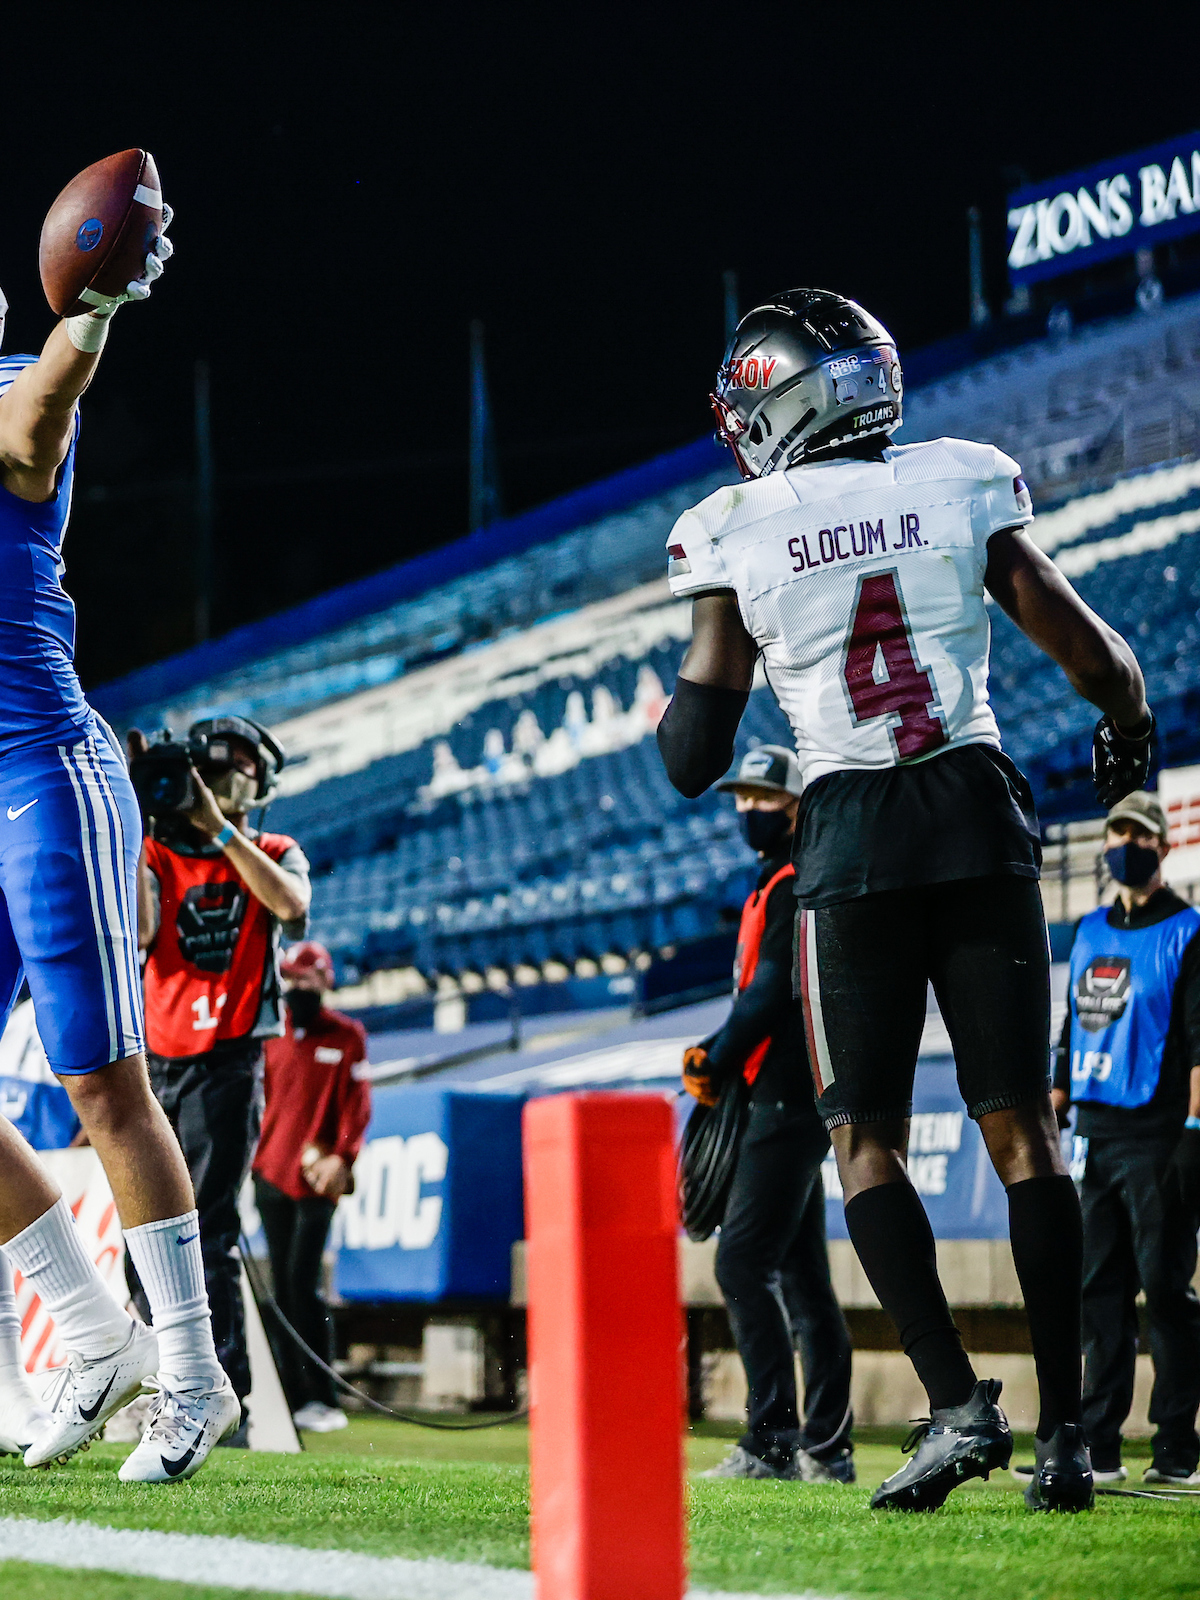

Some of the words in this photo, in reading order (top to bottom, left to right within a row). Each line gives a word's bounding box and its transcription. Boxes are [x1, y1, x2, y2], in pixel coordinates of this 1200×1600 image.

[1008, 173, 1133, 270] ZIONS
[878, 367, 887, 394] 4
[853, 405, 894, 428] TROJANS
[788, 518, 887, 573] SLOCUM
[893, 513, 929, 550] JR.
[838, 566, 951, 767] 4
